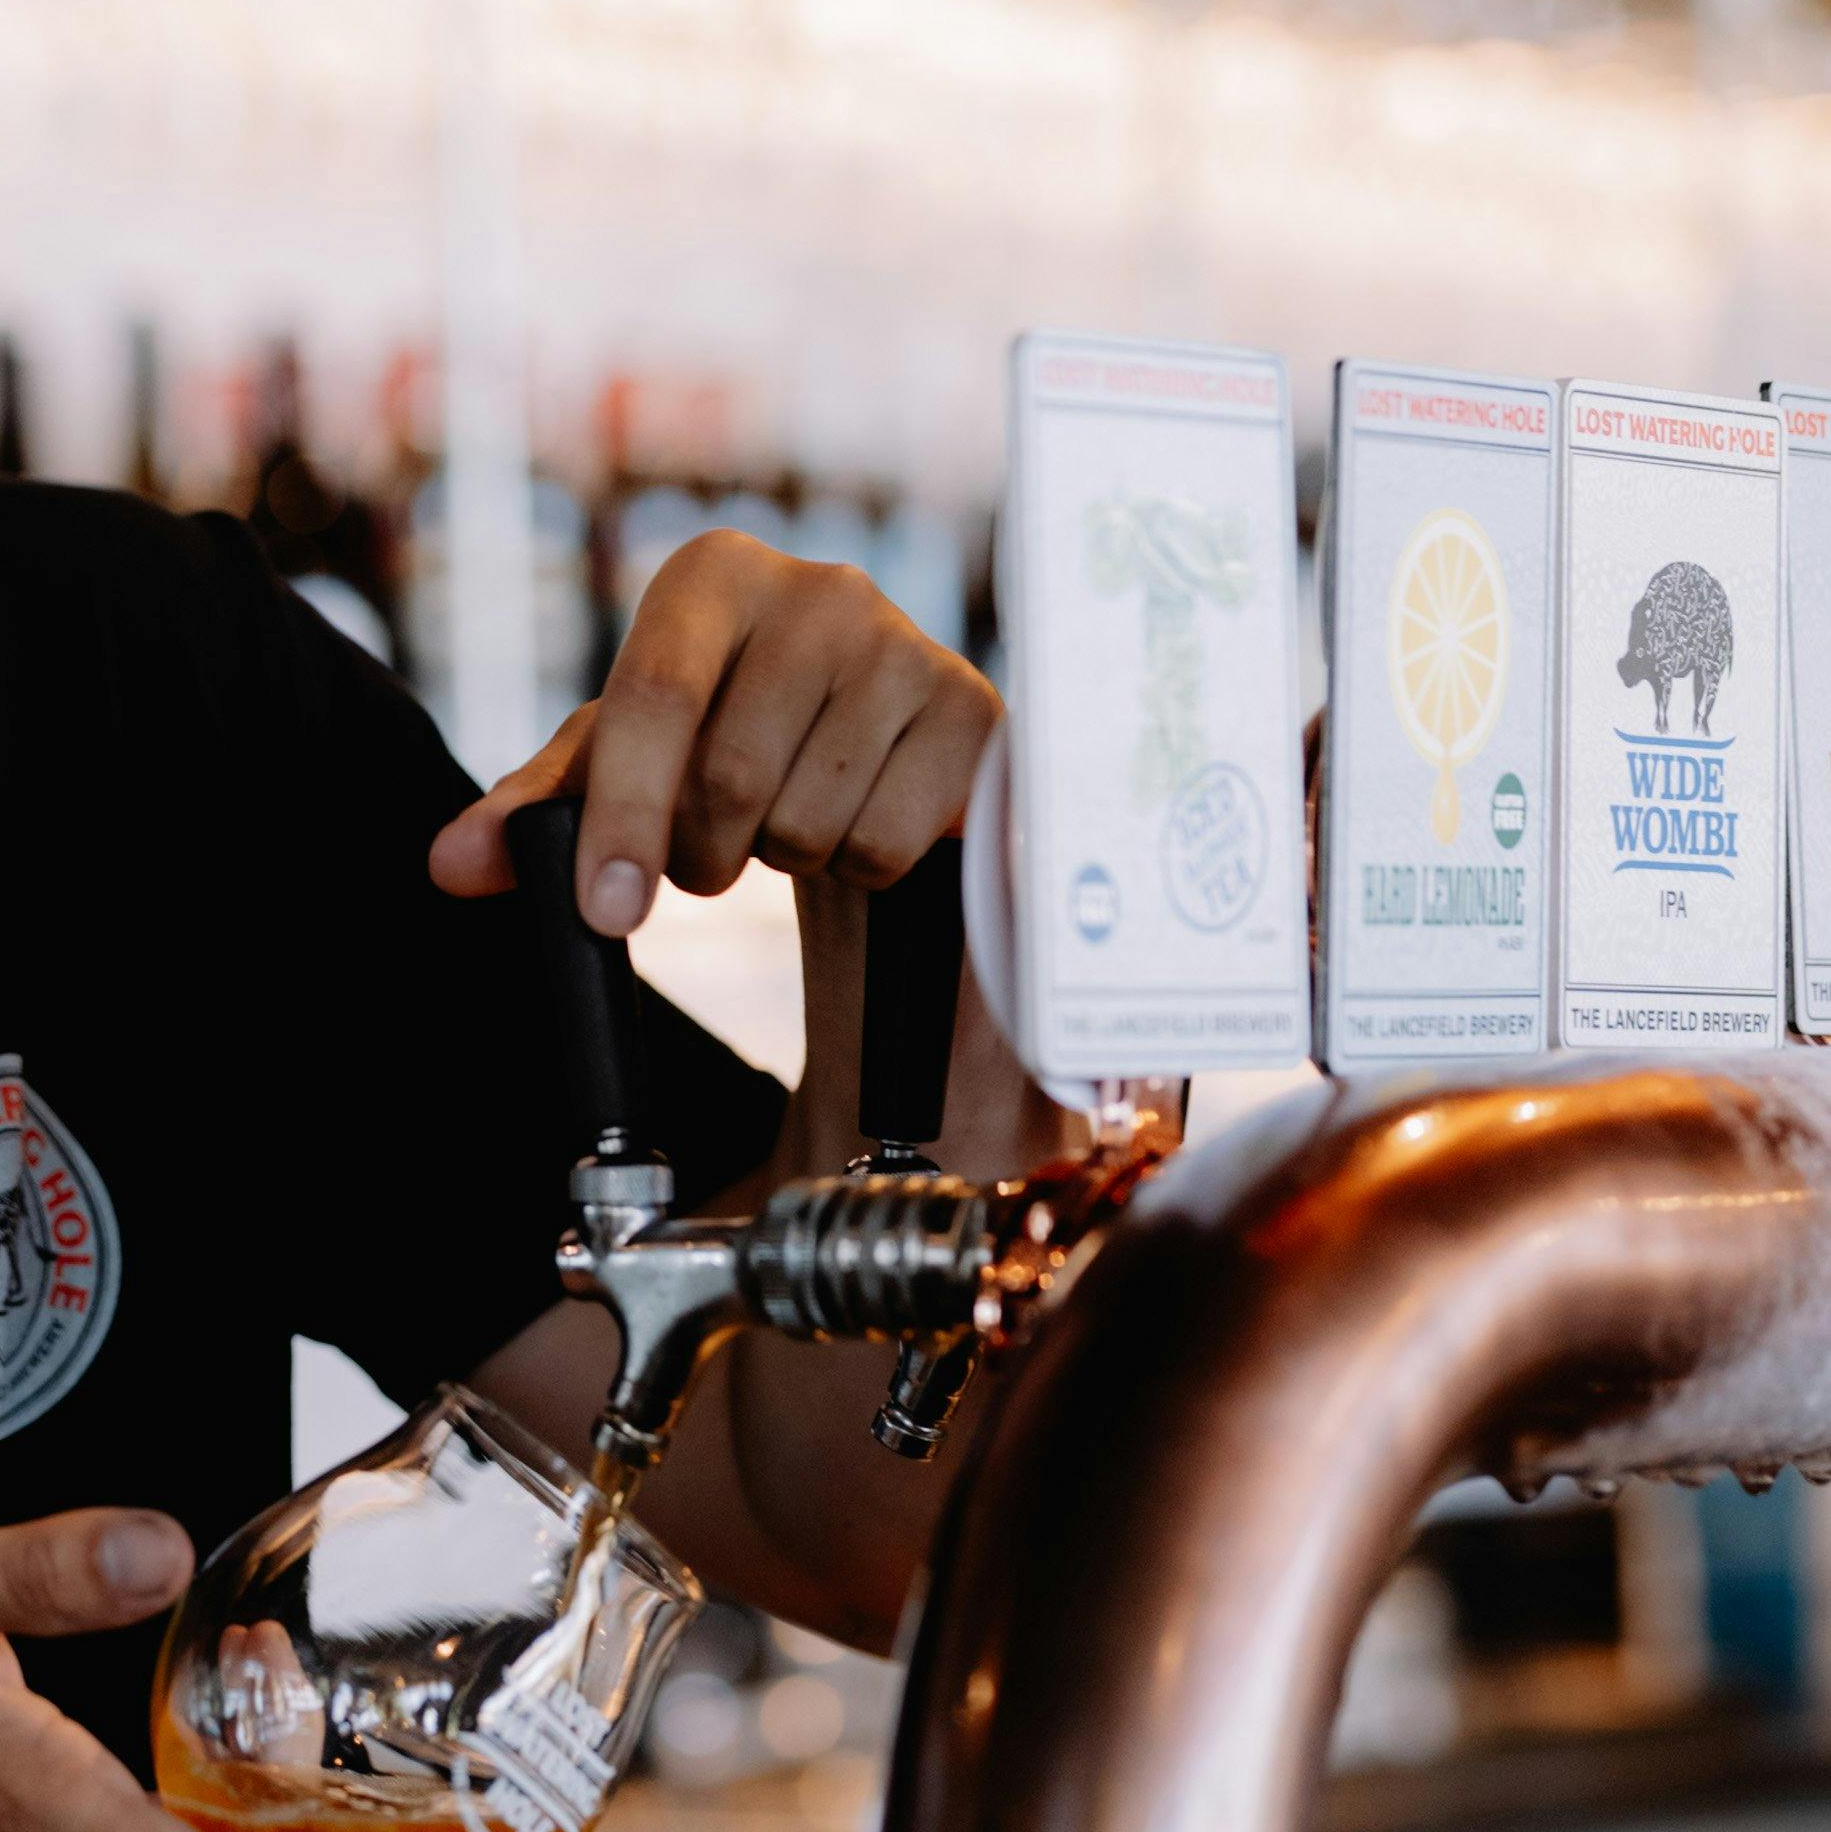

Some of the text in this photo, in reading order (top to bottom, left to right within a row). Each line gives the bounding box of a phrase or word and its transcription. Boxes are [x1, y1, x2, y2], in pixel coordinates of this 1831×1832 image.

[1357, 388, 1545, 435] LOST WATERING HOLE
[1575, 406, 1776, 458] LOST WATERING HOLE
[1785, 407, 1828, 439] LOST
[1625, 751, 1725, 804] WIDE
[1609, 804, 1739, 858] WOMBI
[1422, 866, 1525, 927] LEMONADE
[1659, 889, 1688, 918] IPA
[1811, 981, 1831, 1002] TH
[1470, 1014, 1534, 1036] BREWERY
[1572, 1008, 1771, 1034] THE LANCEFIELD BREWERY
[40, 1170, 94, 1314] HOLE
